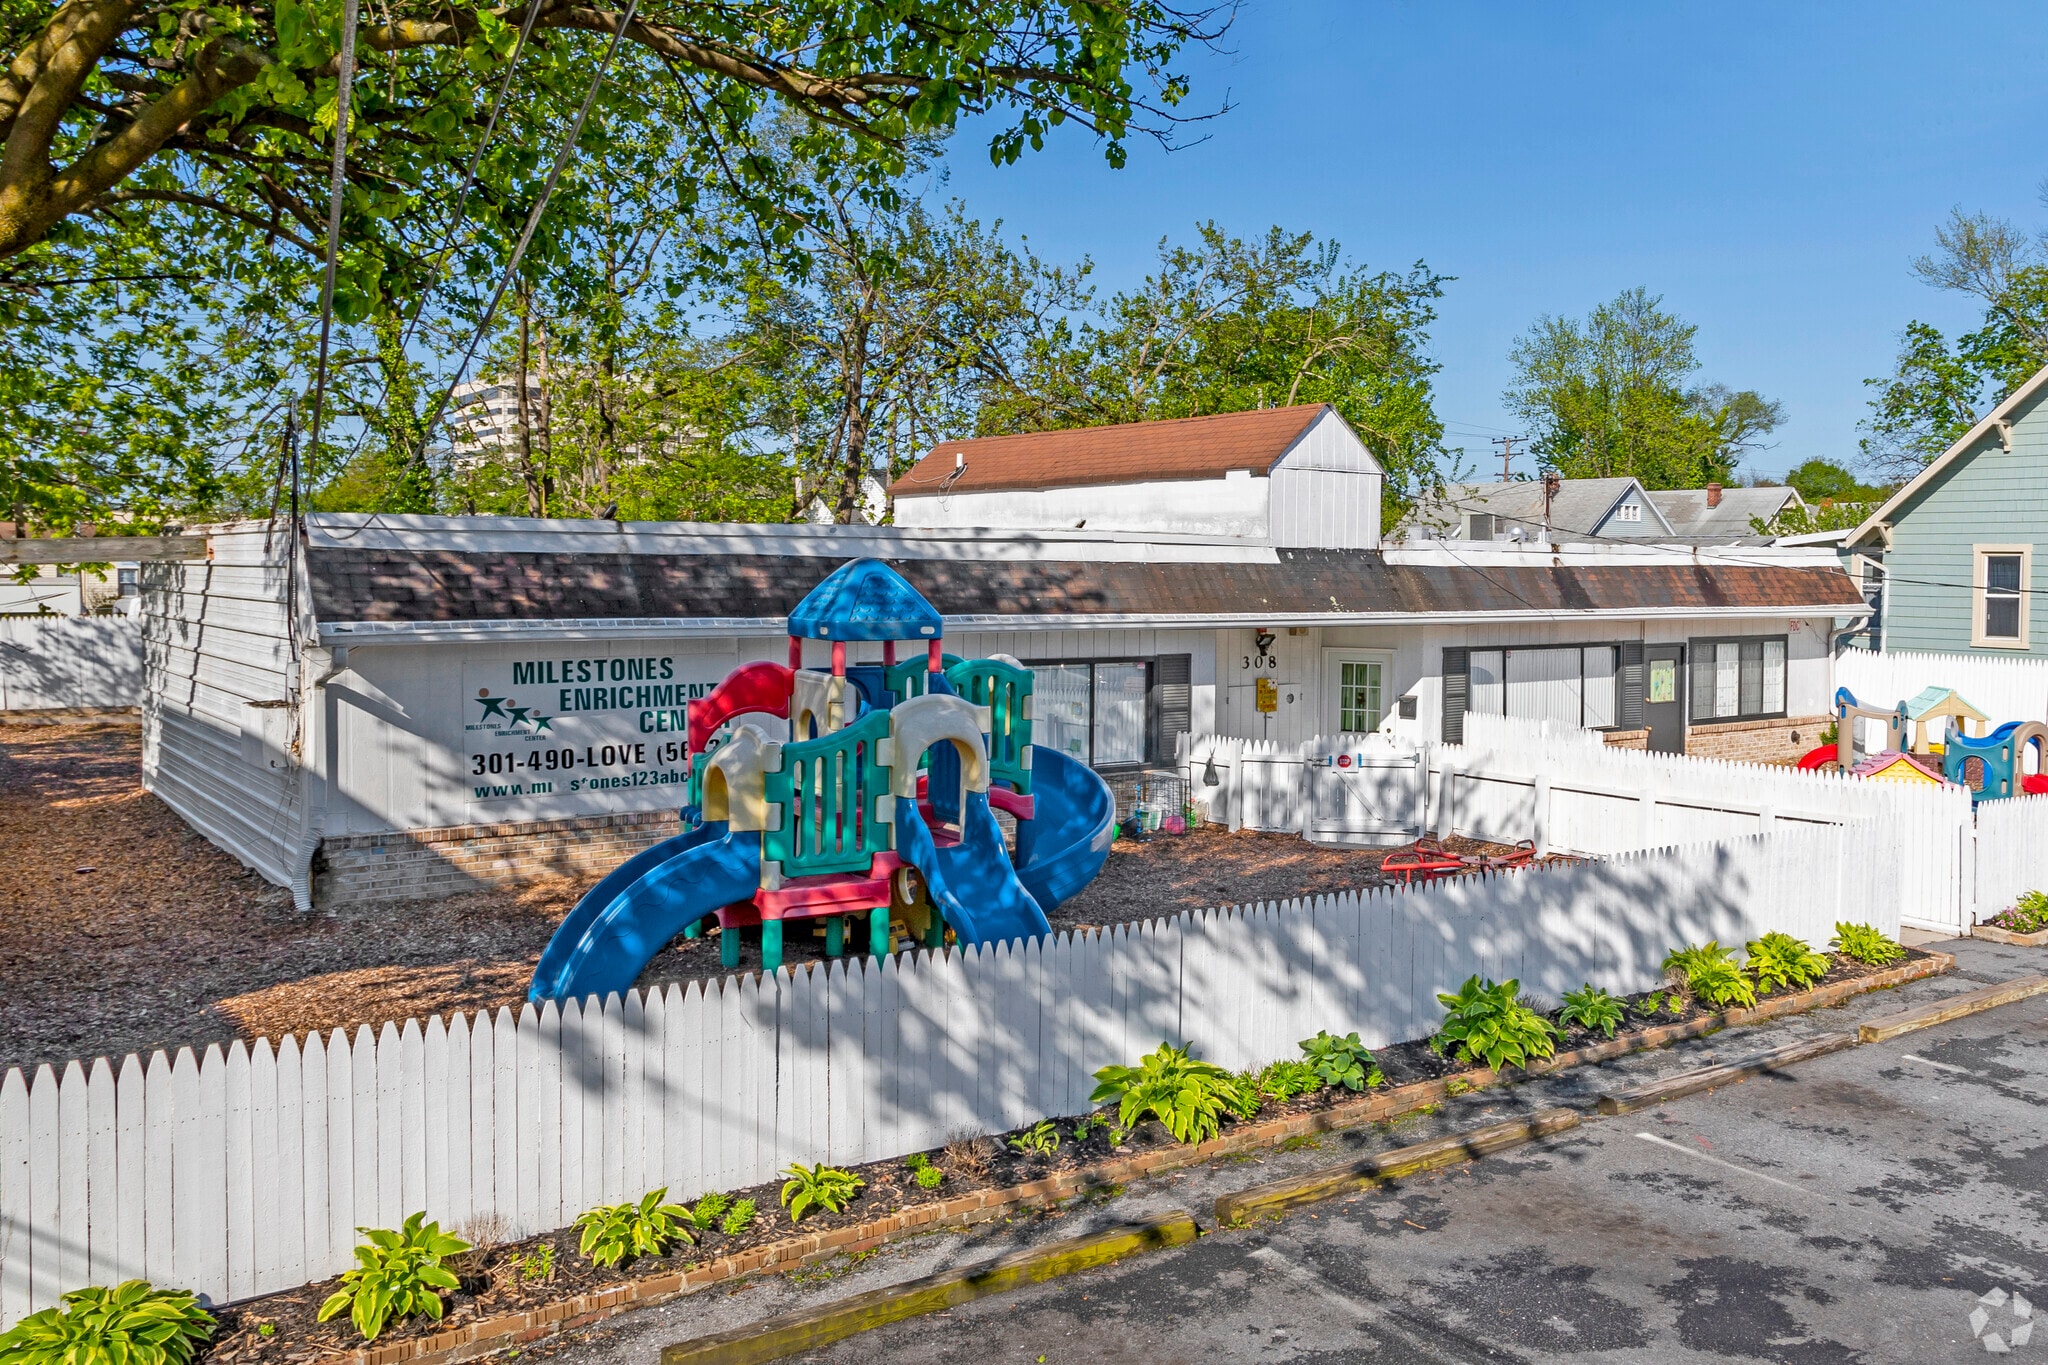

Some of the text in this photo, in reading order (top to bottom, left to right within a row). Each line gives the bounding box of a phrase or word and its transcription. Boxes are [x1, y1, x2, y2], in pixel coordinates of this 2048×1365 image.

[513, 657, 673, 685] MILESTONES
[1242, 655, 1276, 669] 308
[472, 743, 645, 776] 301-490-LOVE
